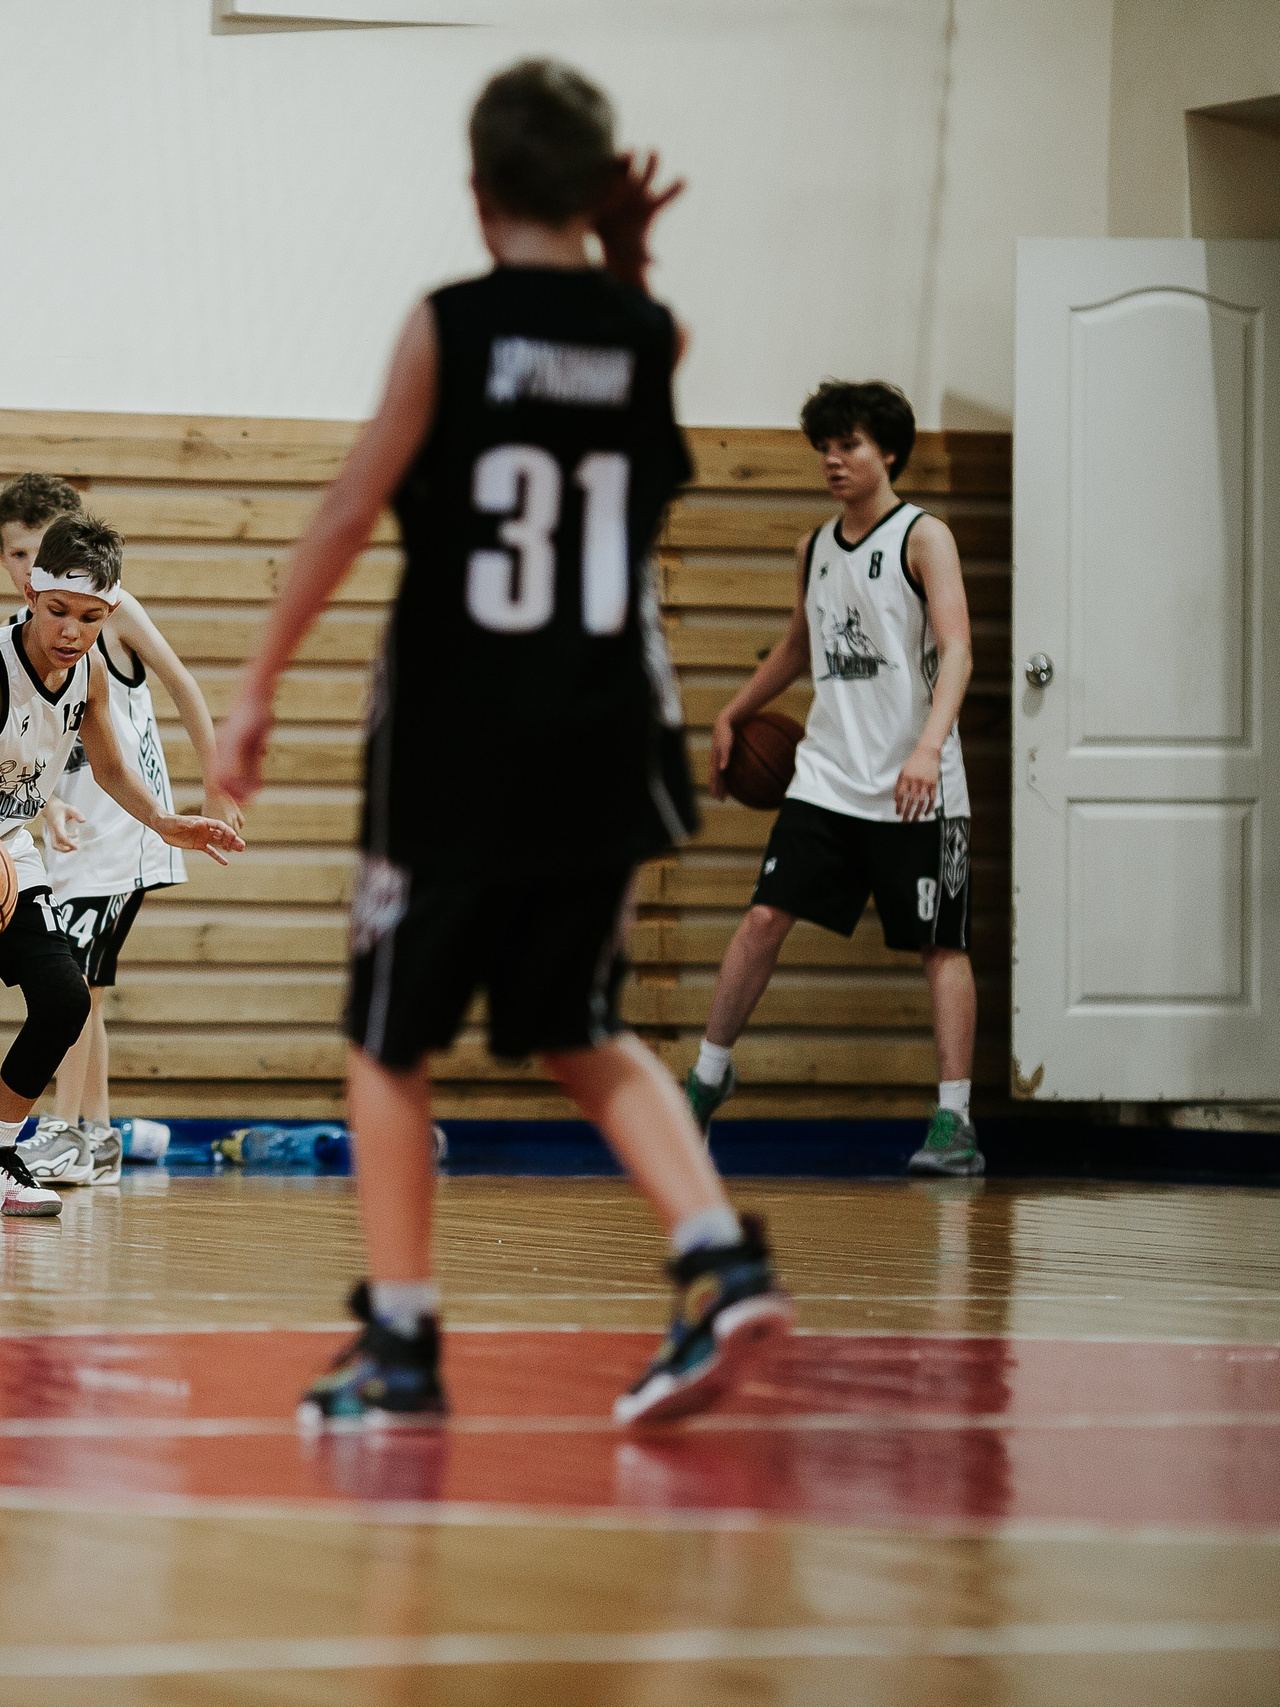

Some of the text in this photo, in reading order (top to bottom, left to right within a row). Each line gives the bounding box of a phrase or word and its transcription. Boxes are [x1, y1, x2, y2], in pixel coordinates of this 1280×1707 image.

[467, 444, 630, 636] 31
[869, 551, 883, 579] 8
[62, 701, 86, 735] 13
[917, 877, 937, 921] 8
